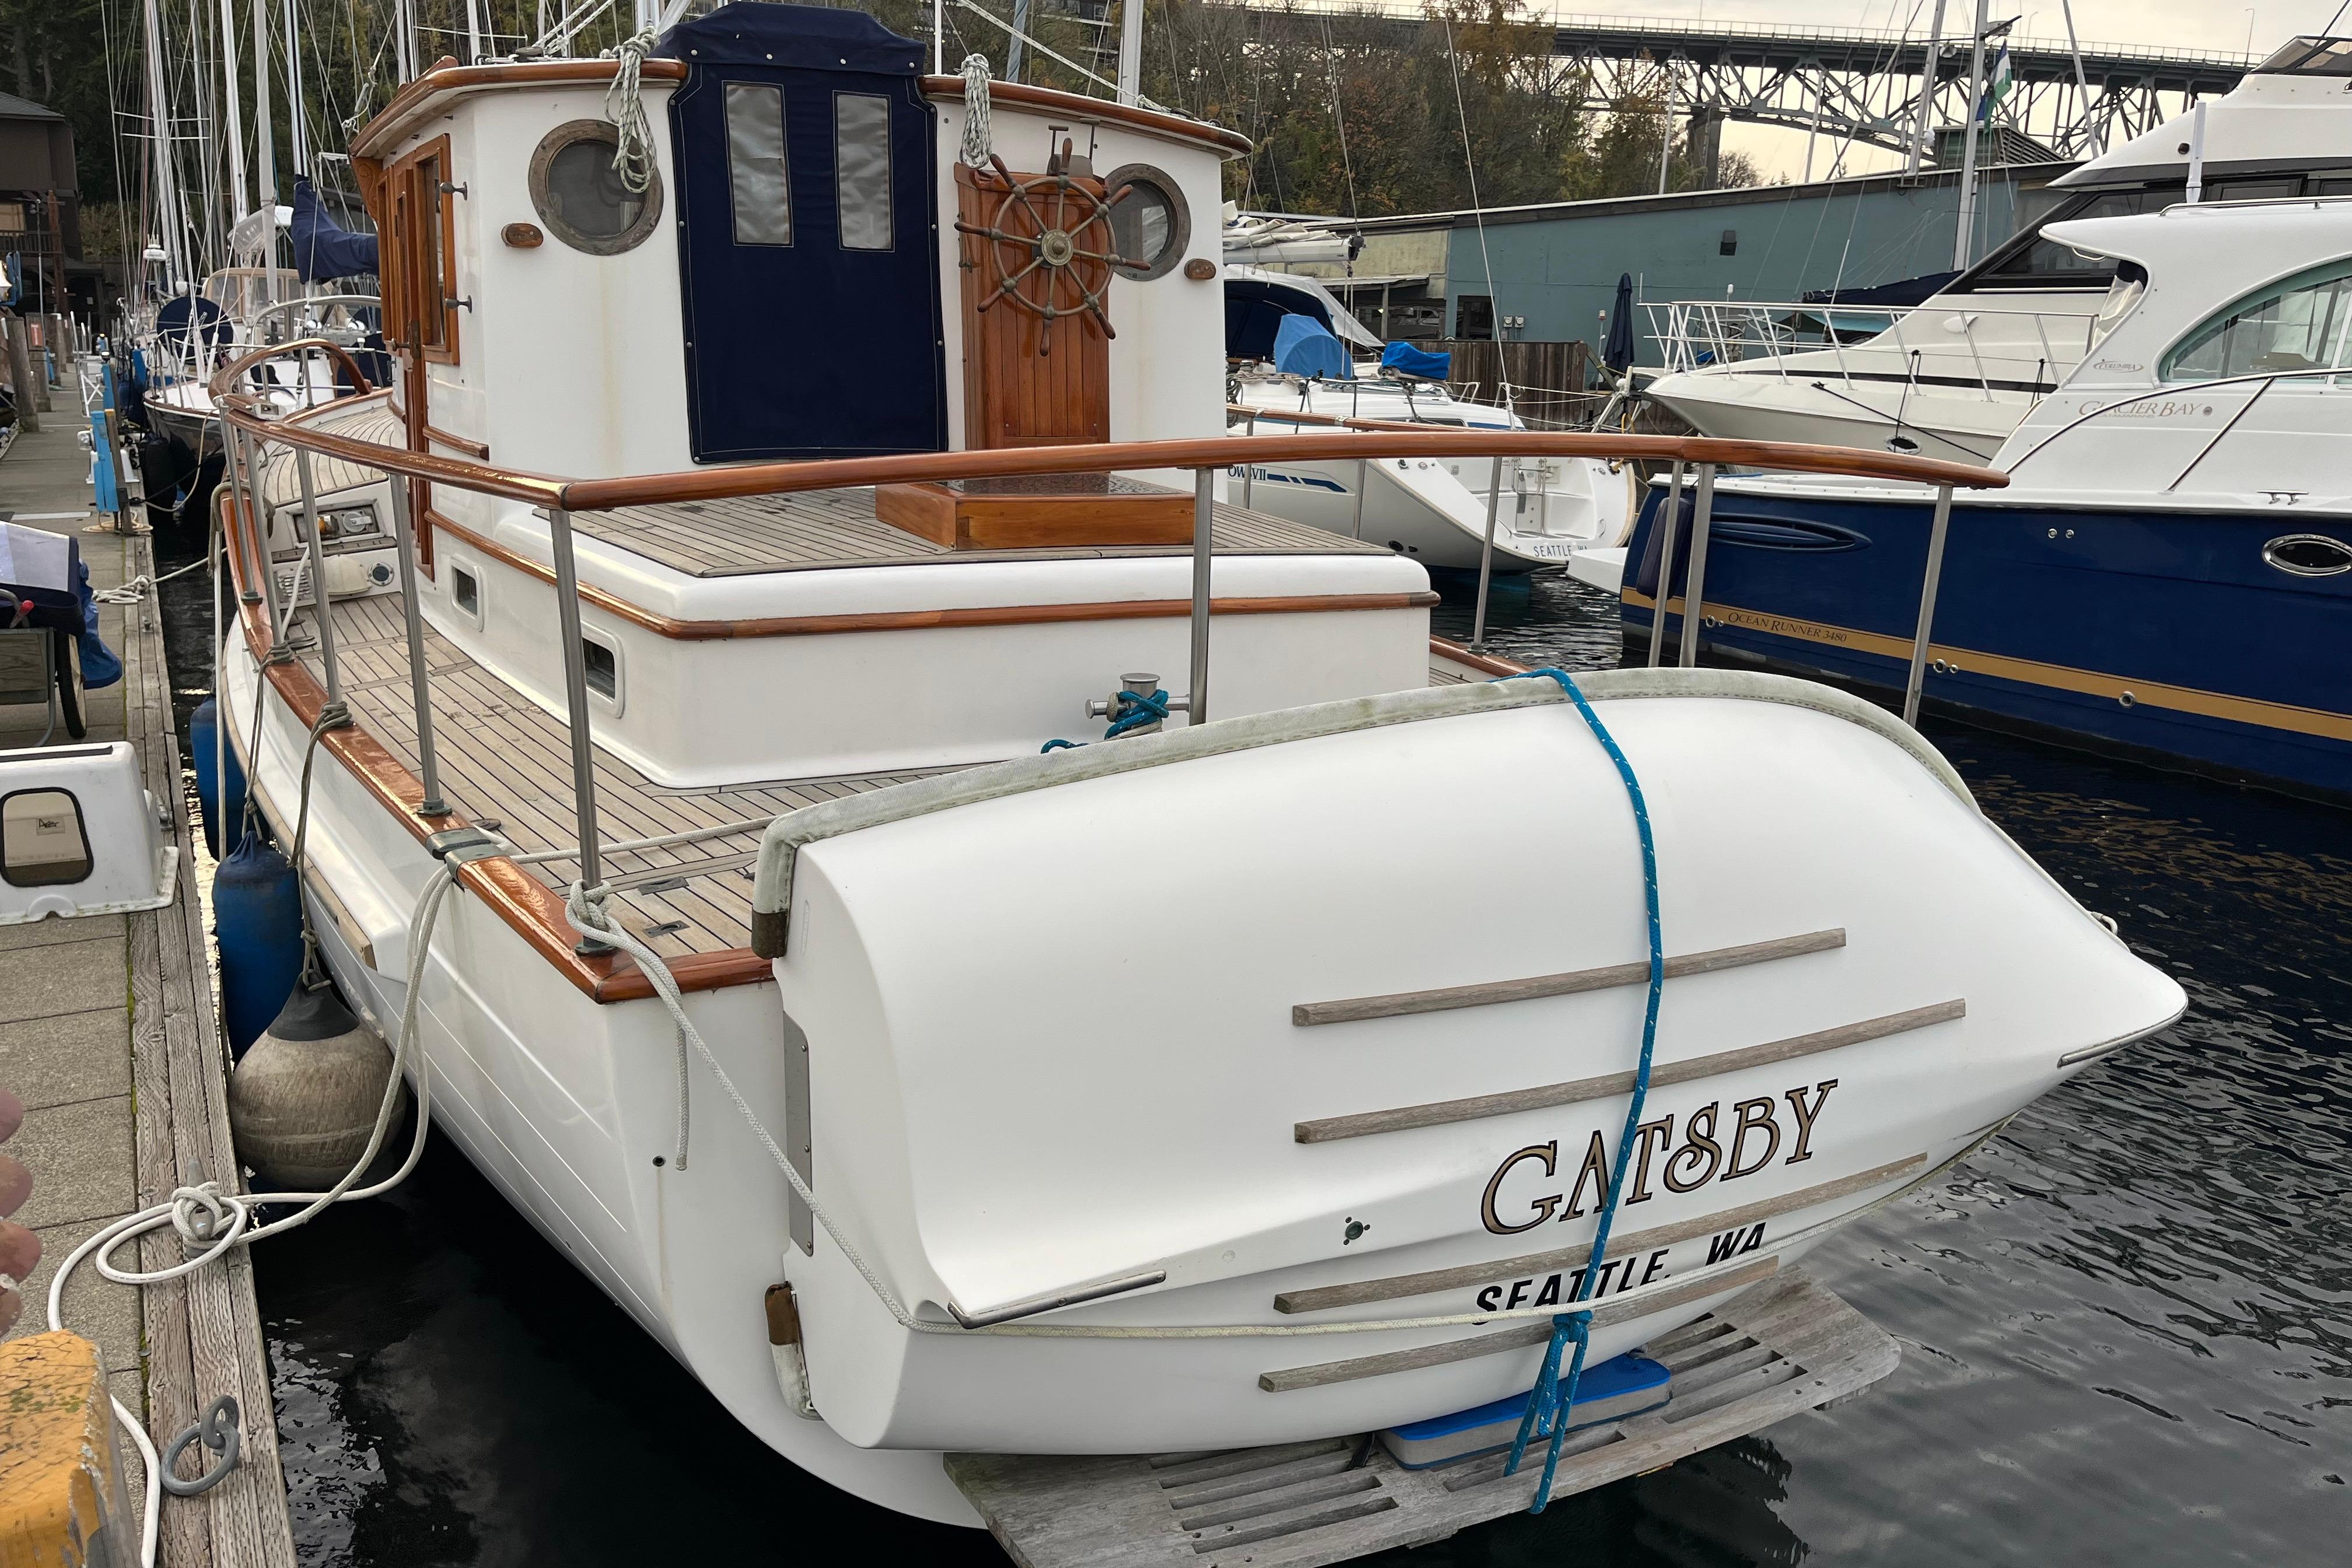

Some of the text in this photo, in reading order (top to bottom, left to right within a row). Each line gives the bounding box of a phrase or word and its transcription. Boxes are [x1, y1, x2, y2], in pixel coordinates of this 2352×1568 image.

[2078, 400, 2203, 416] GCIER BAY
[1533, 545, 1572, 557] SEATTLE
[1728, 612, 1847, 642] OCEAN RUNNER 3480
[1480, 1078, 1839, 1236] GATSBY
[1472, 1222, 1766, 1326] SEATTLE WA
